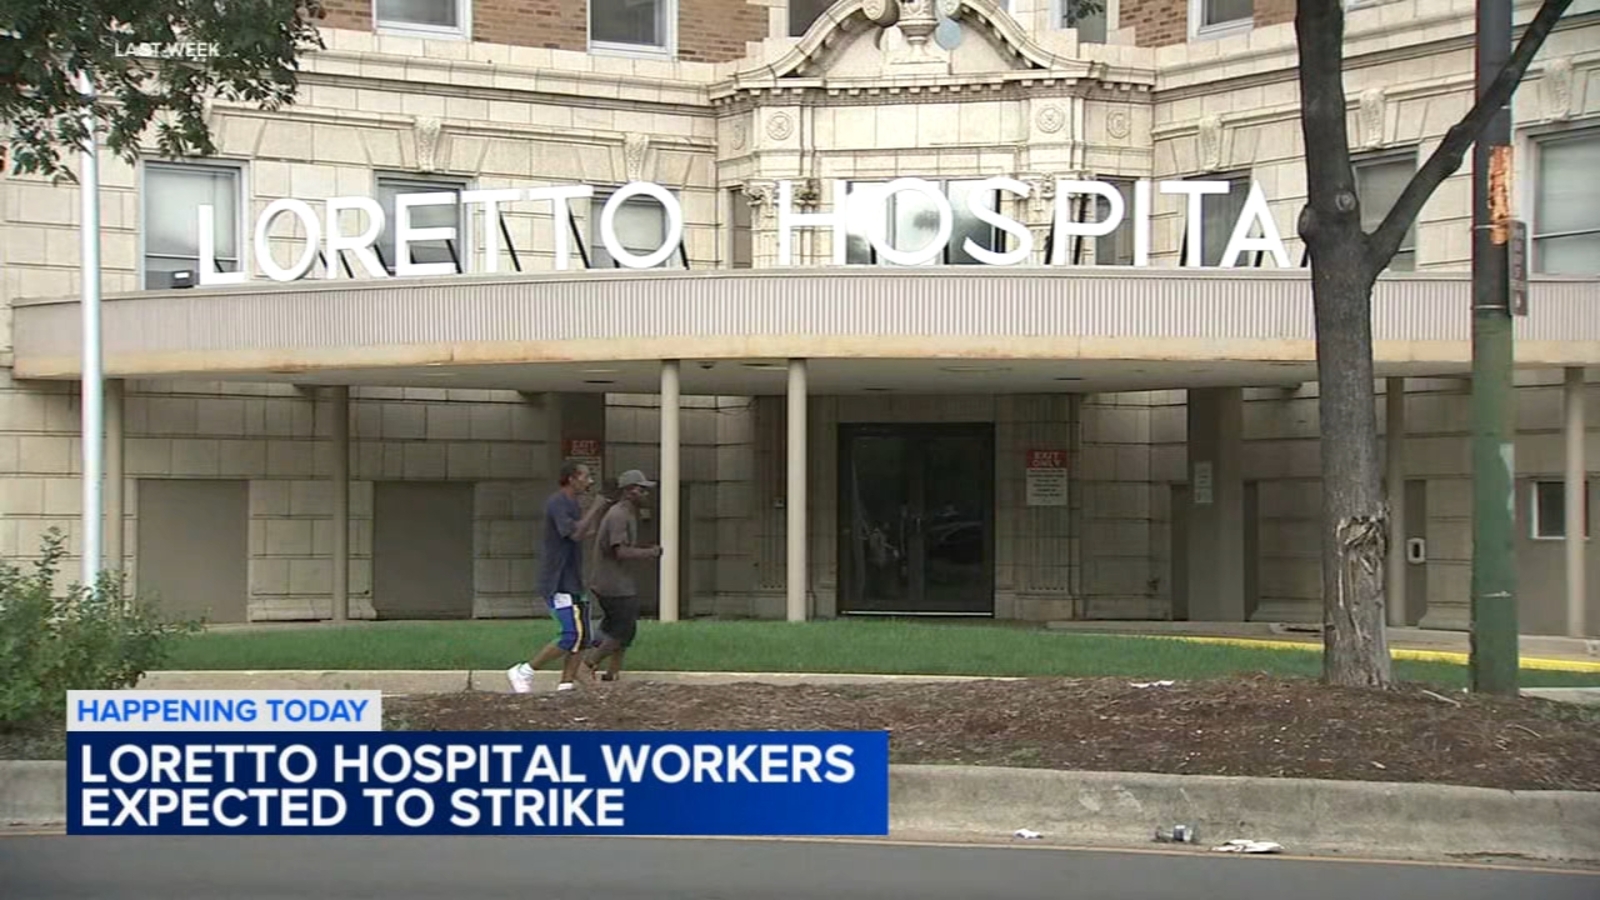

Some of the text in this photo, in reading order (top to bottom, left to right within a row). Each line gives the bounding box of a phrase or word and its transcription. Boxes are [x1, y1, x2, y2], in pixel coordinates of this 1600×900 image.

[198, 177, 1292, 286] LORETTO HOSPITA
[1034, 451, 1060, 460] EXIT
